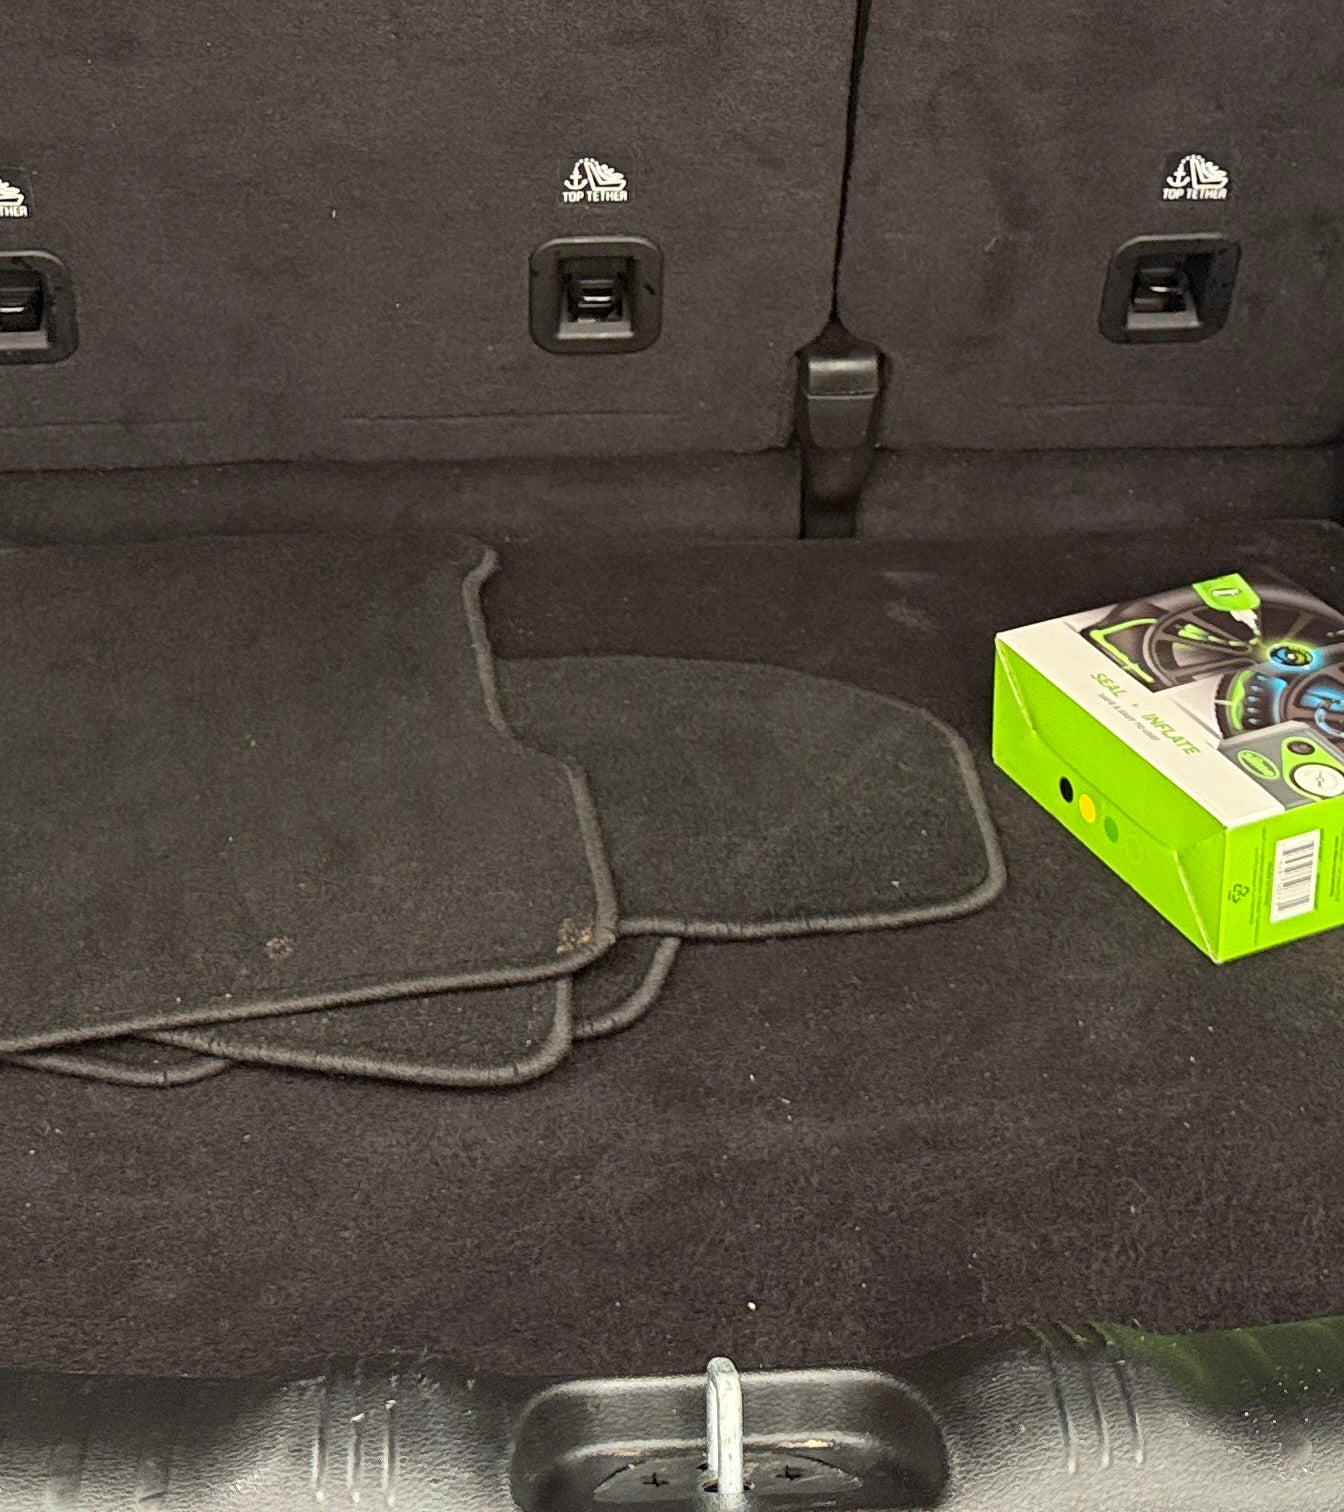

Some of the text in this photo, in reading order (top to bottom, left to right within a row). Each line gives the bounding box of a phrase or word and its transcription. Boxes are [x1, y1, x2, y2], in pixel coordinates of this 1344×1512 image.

[562, 190, 628, 203] TOP TETHER
[1162, 188, 1228, 200] TOP TETHER
[1091, 672, 1202, 756] SEAL INFLATE
